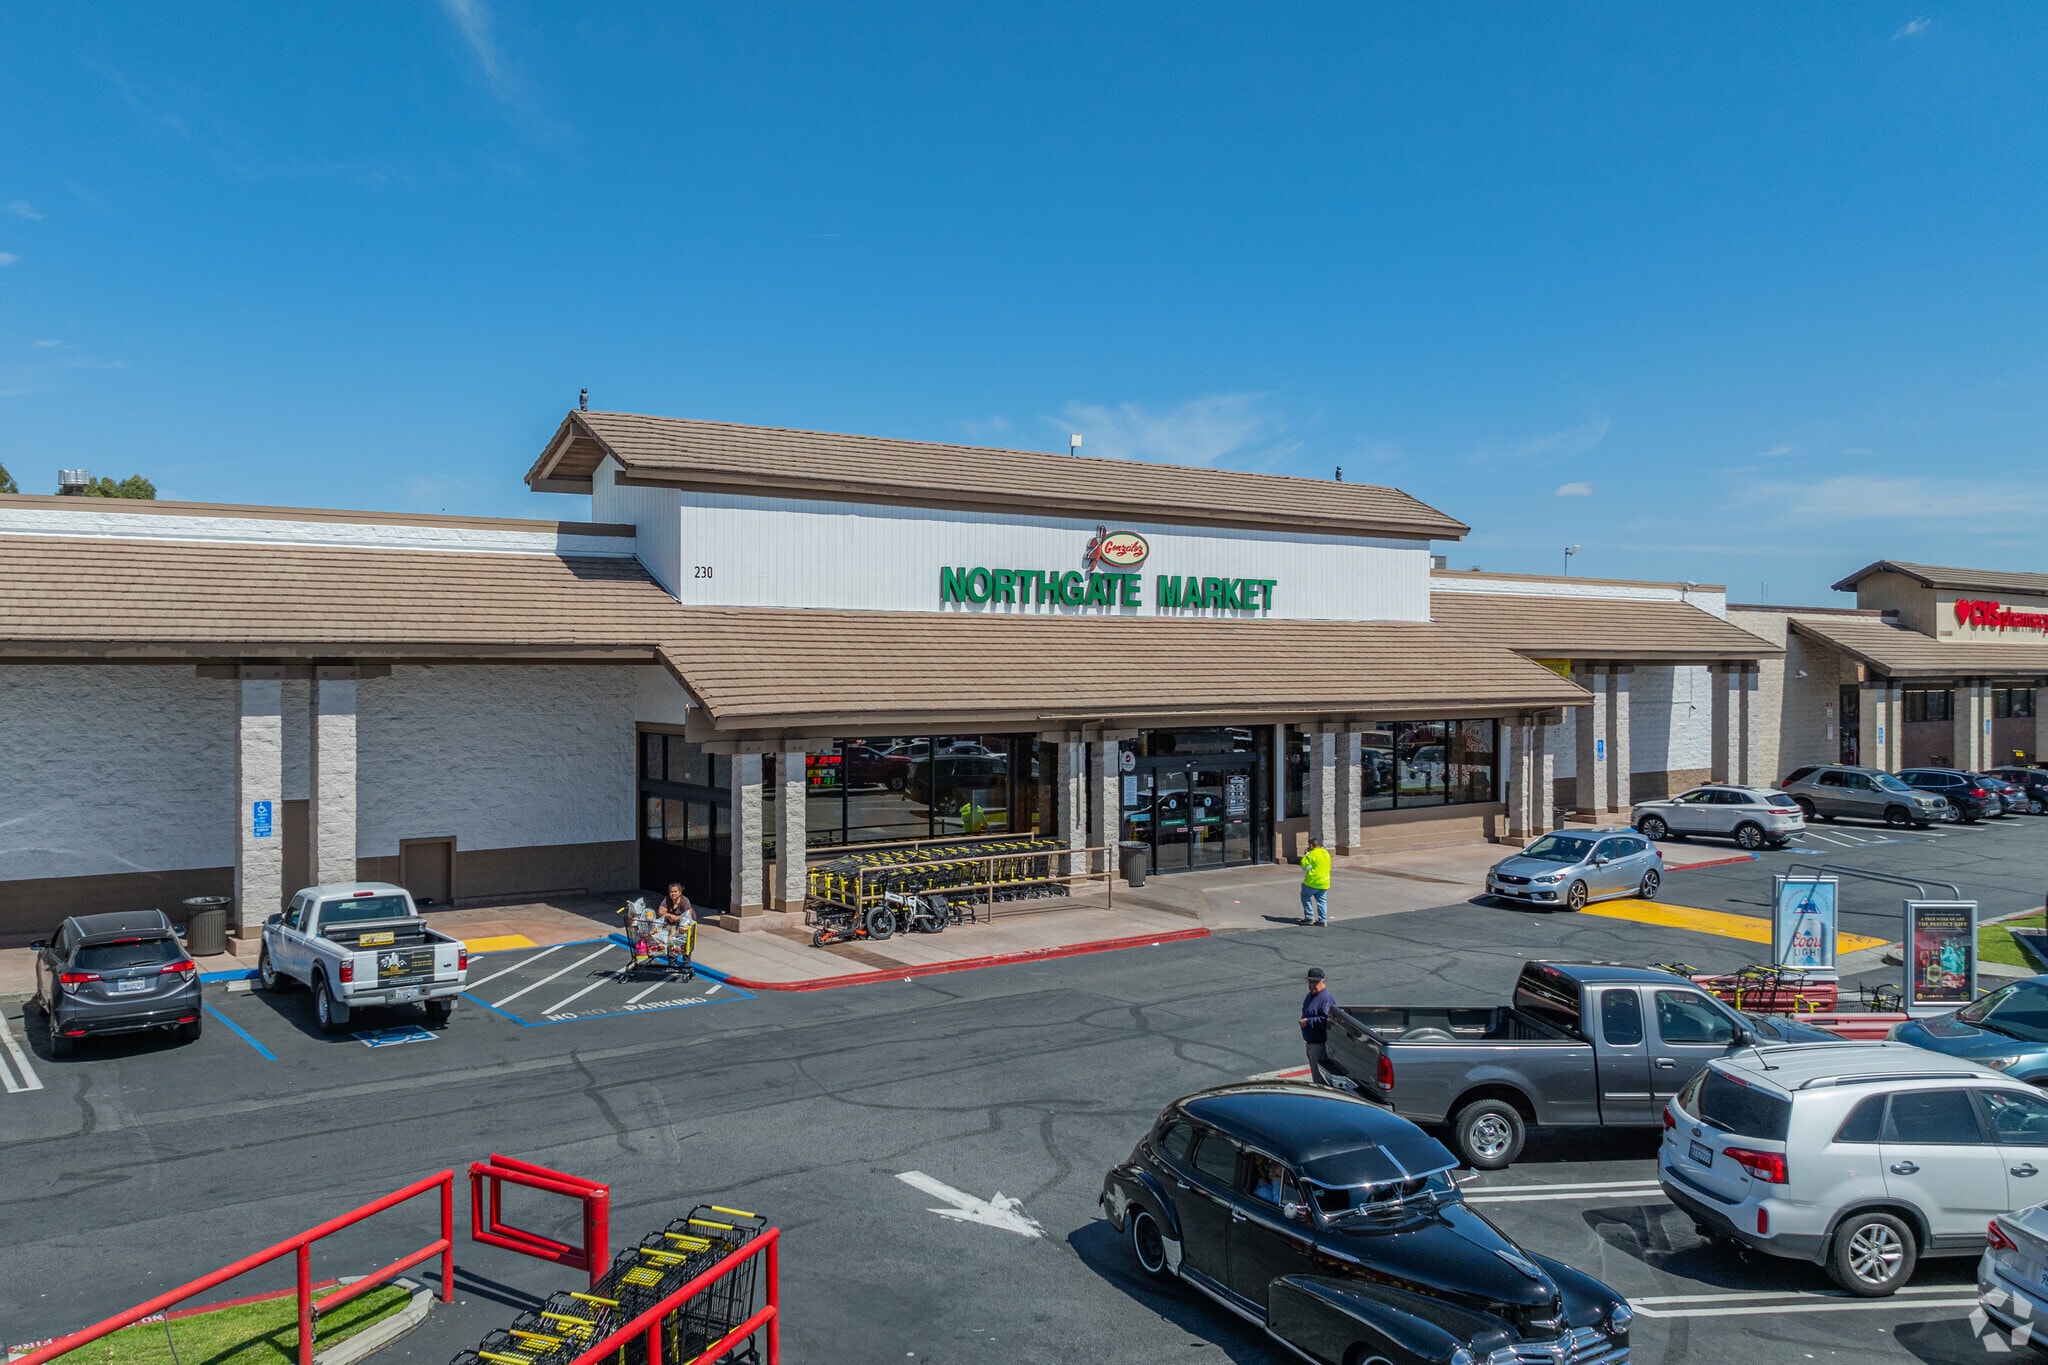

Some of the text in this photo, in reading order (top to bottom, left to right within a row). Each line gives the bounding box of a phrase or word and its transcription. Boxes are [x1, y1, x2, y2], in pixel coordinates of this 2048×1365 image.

[694, 566, 713, 579] 230
[941, 566, 1278, 611] NORTHGATE MARKET
[1970, 600, 2001, 627] CVS
[546, 1012, 578, 1022] NO
[622, 996, 709, 1012] PARKING
